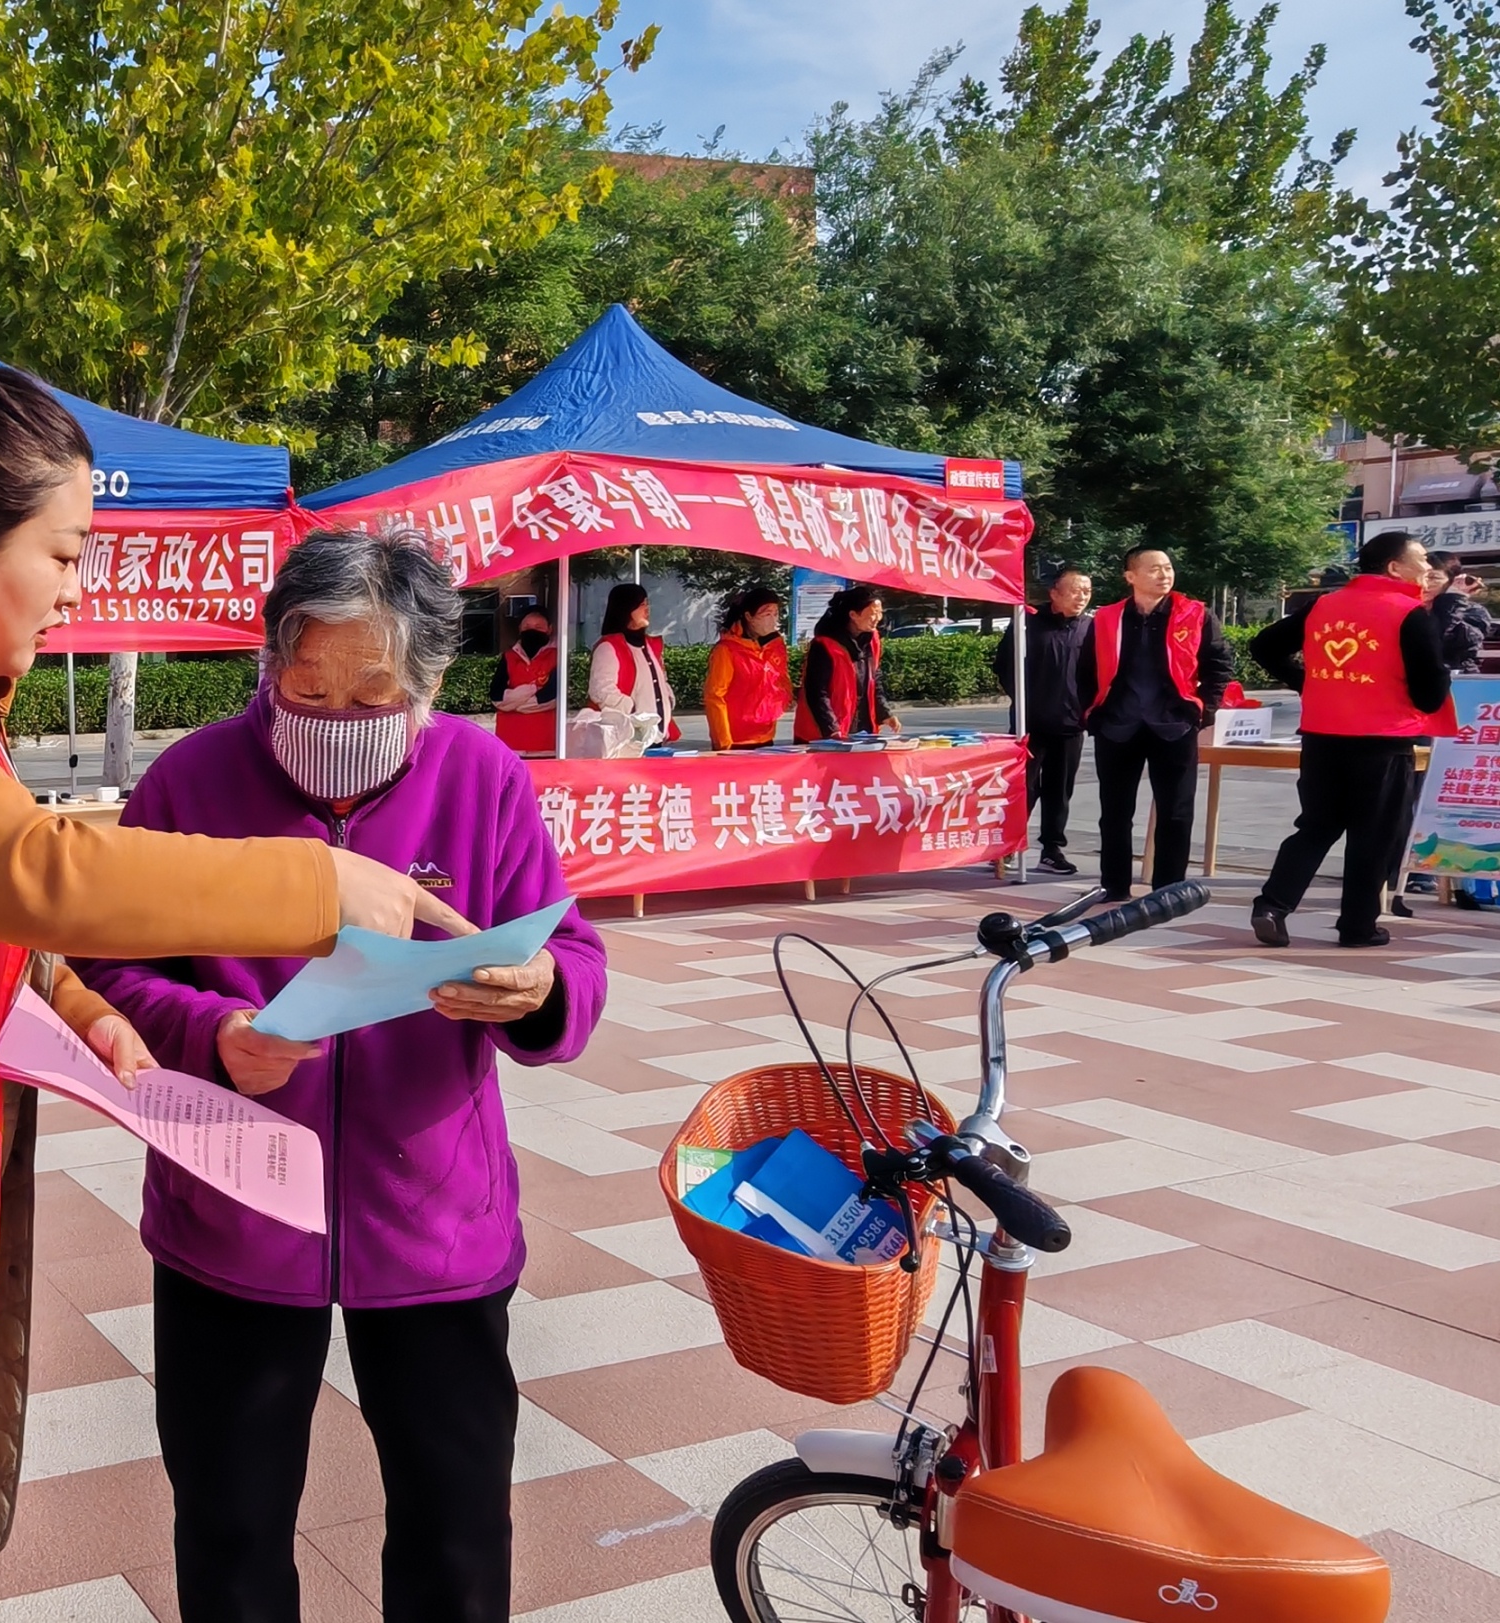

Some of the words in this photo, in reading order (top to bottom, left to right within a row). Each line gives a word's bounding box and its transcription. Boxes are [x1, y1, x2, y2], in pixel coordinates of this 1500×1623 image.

[949, 470, 1001, 488] 政策宣传专区
[1411, 520, 1500, 548] 老吉祥
[711, 766, 1010, 850] 共建老年友好社会
[920, 828, 1005, 851] 蠡县民政局宣
